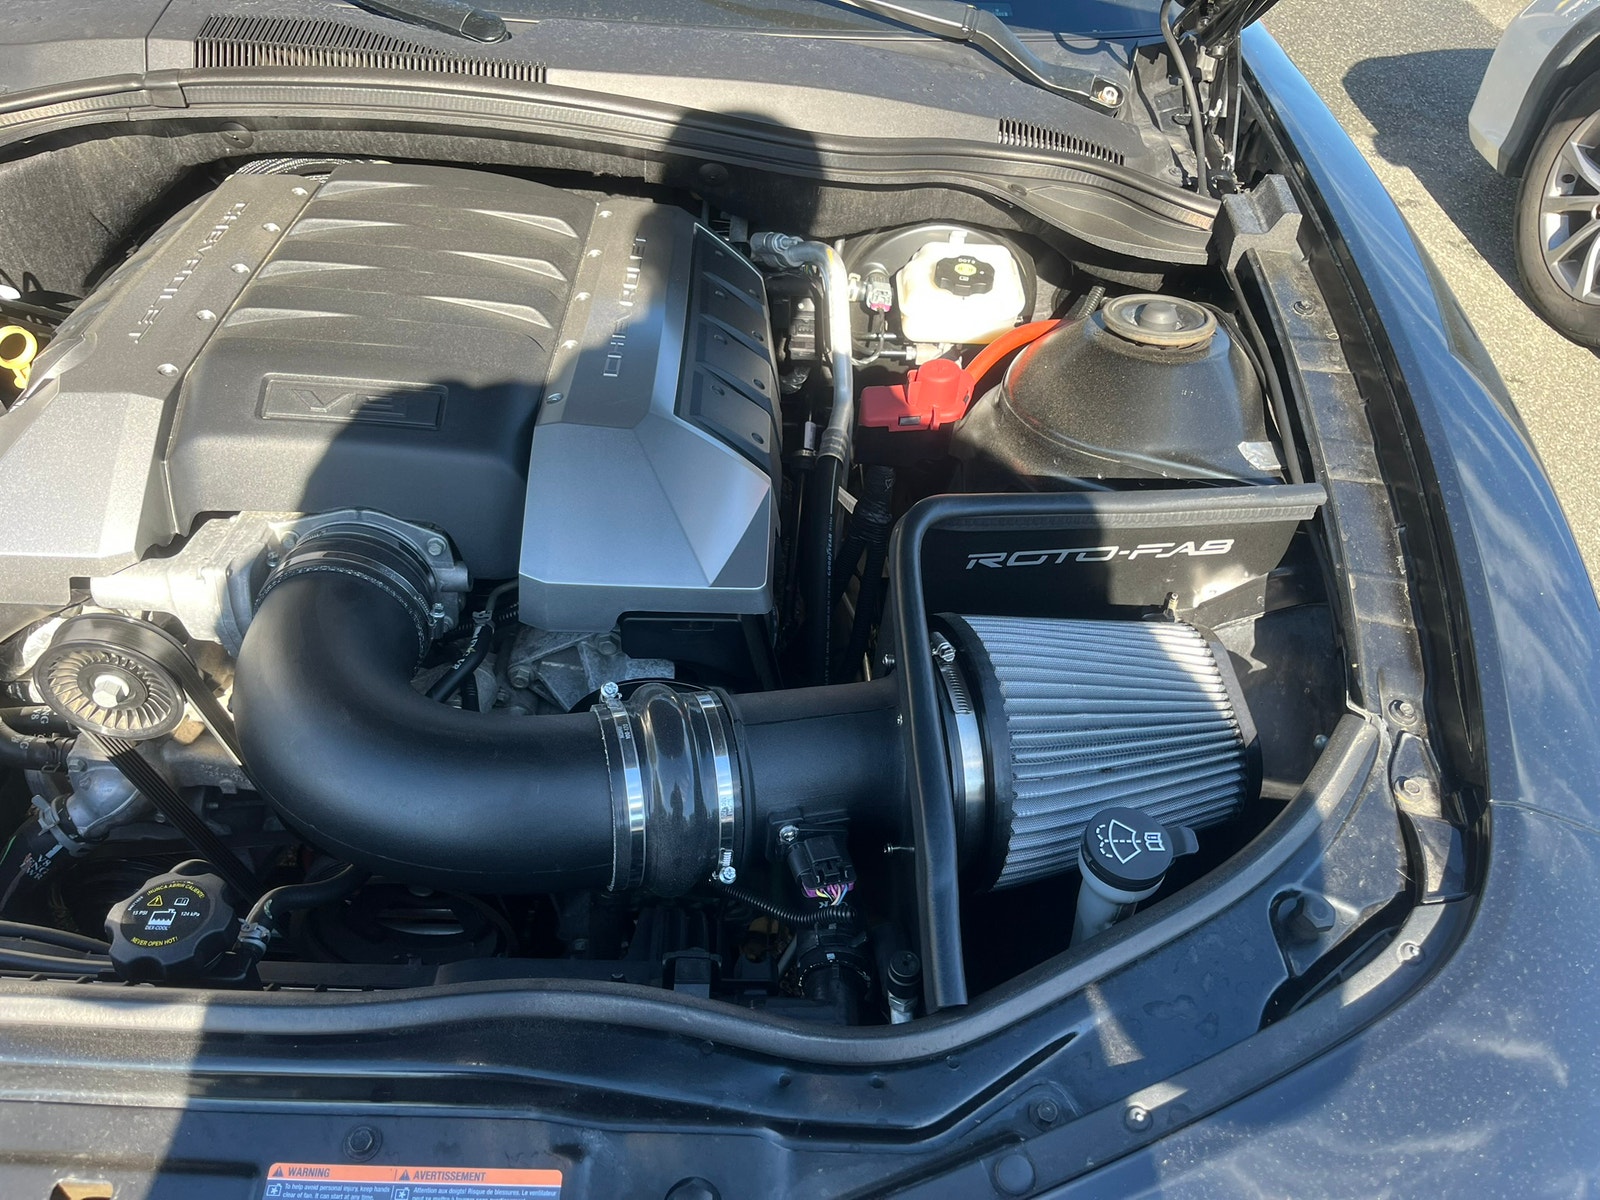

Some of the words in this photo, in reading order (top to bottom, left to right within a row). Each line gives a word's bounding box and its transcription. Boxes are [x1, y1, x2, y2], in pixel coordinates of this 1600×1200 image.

[128, 203, 249, 344] CHEVROLET
[603, 232, 647, 377] CHEVROLET
[965, 538, 1235, 570] ROTO-FAB
[131, 936, 147, 946] NEVER
[288, 1167, 330, 1177] WARNING
[413, 1170, 486, 1181] AVERTISSEMENT
